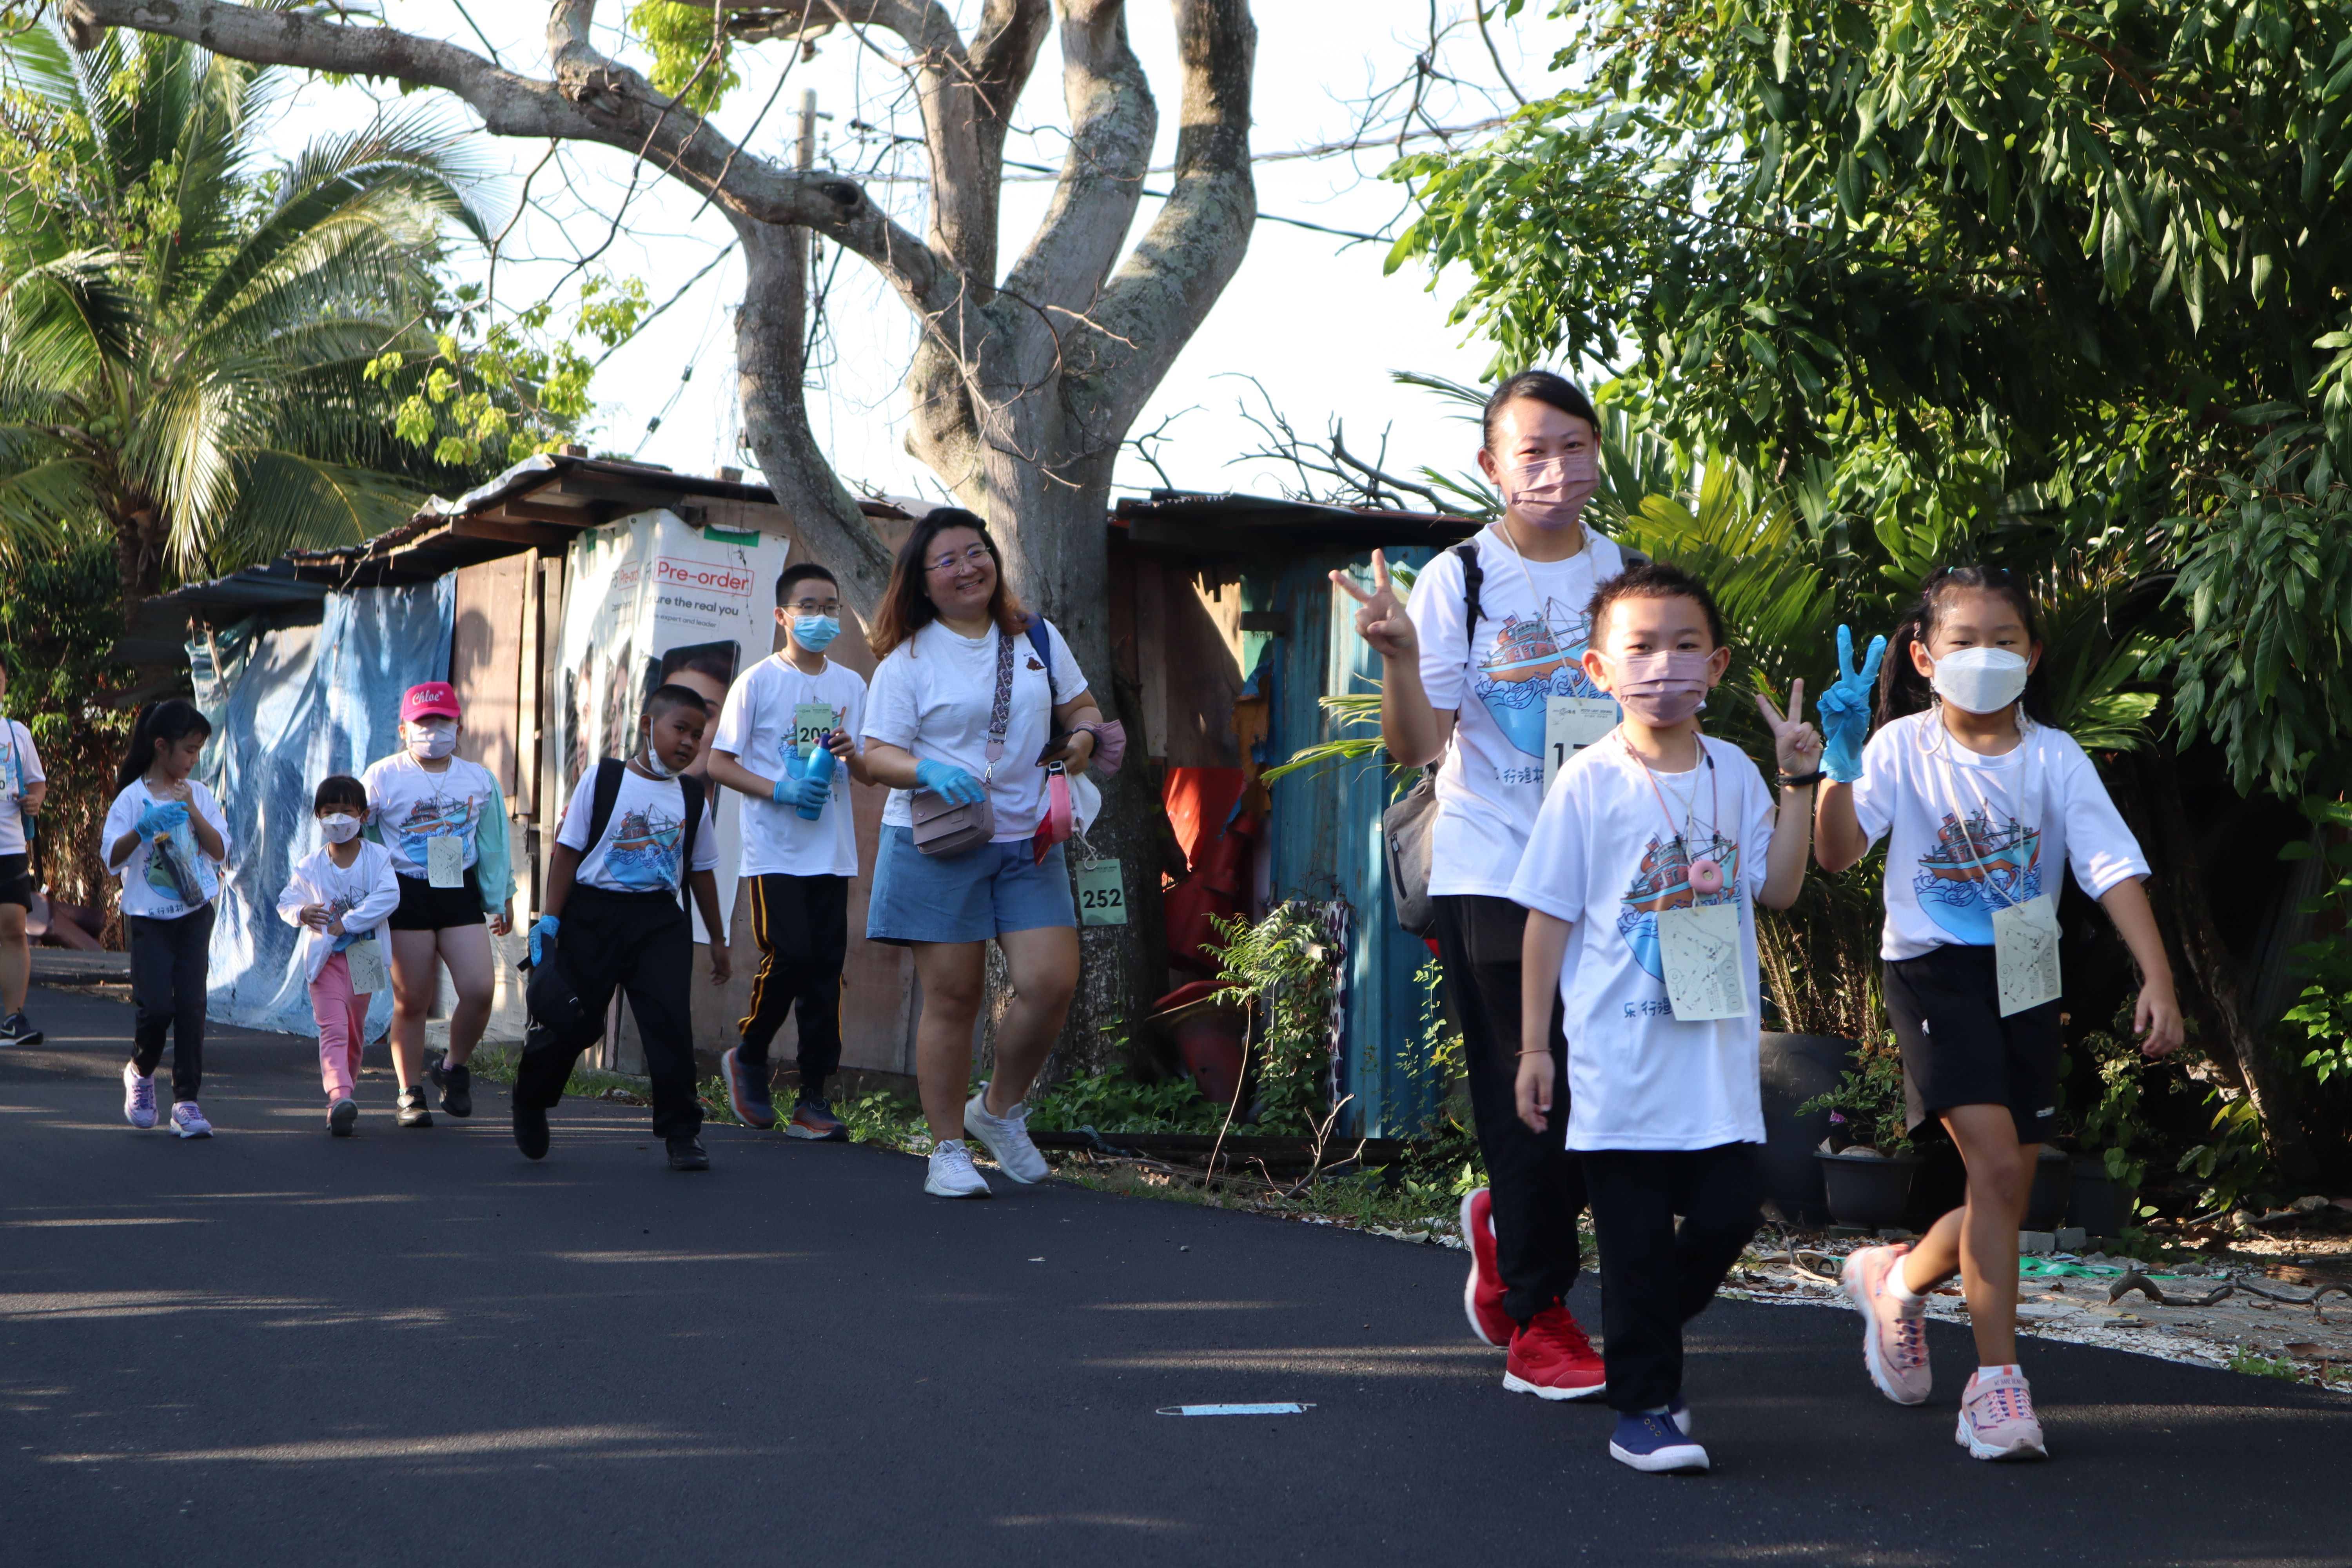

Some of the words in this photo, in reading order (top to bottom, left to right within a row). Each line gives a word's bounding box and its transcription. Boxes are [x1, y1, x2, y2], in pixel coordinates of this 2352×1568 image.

[657, 561, 749, 590] Pre-order
[675, 596, 692, 608] the
[695, 602, 717, 612] real
[719, 607, 739, 616] you
[661, 615, 681, 624] expert
[696, 619, 717, 628] leader
[412, 690, 440, 705] Chloe
[1083, 888, 1123, 909] 252
